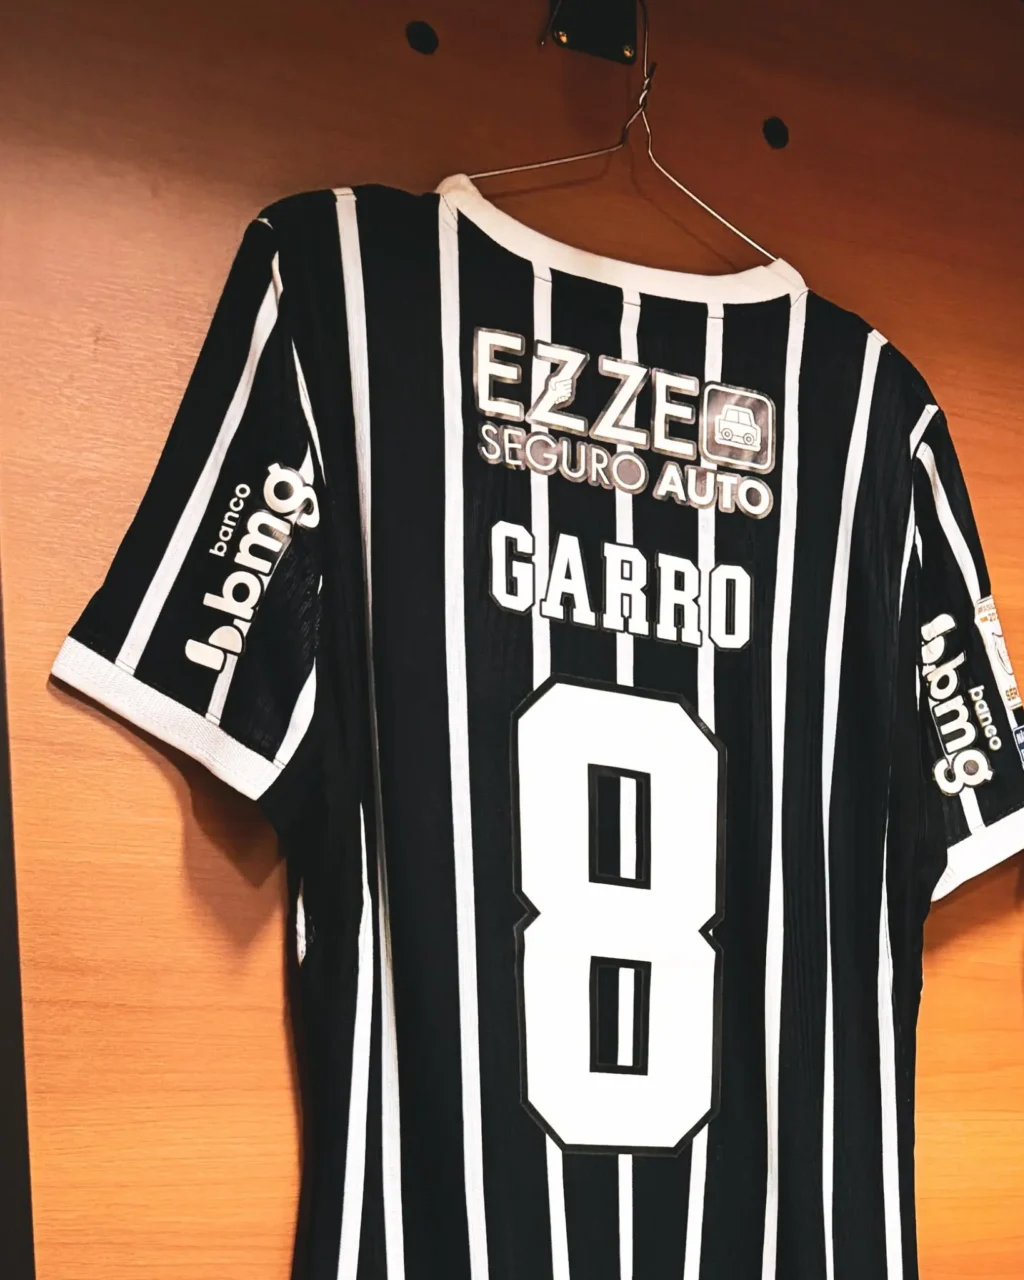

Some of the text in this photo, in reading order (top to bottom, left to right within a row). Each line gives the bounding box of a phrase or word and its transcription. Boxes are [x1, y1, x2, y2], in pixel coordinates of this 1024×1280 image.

[475, 328, 700, 457] EZZE
[208, 482, 251, 557] banco
[480, 422, 772, 516] SEGURO AUTO
[490, 519, 752, 650] GARRO
[968, 684, 1002, 751] banco
[517, 681, 720, 1149] 8
